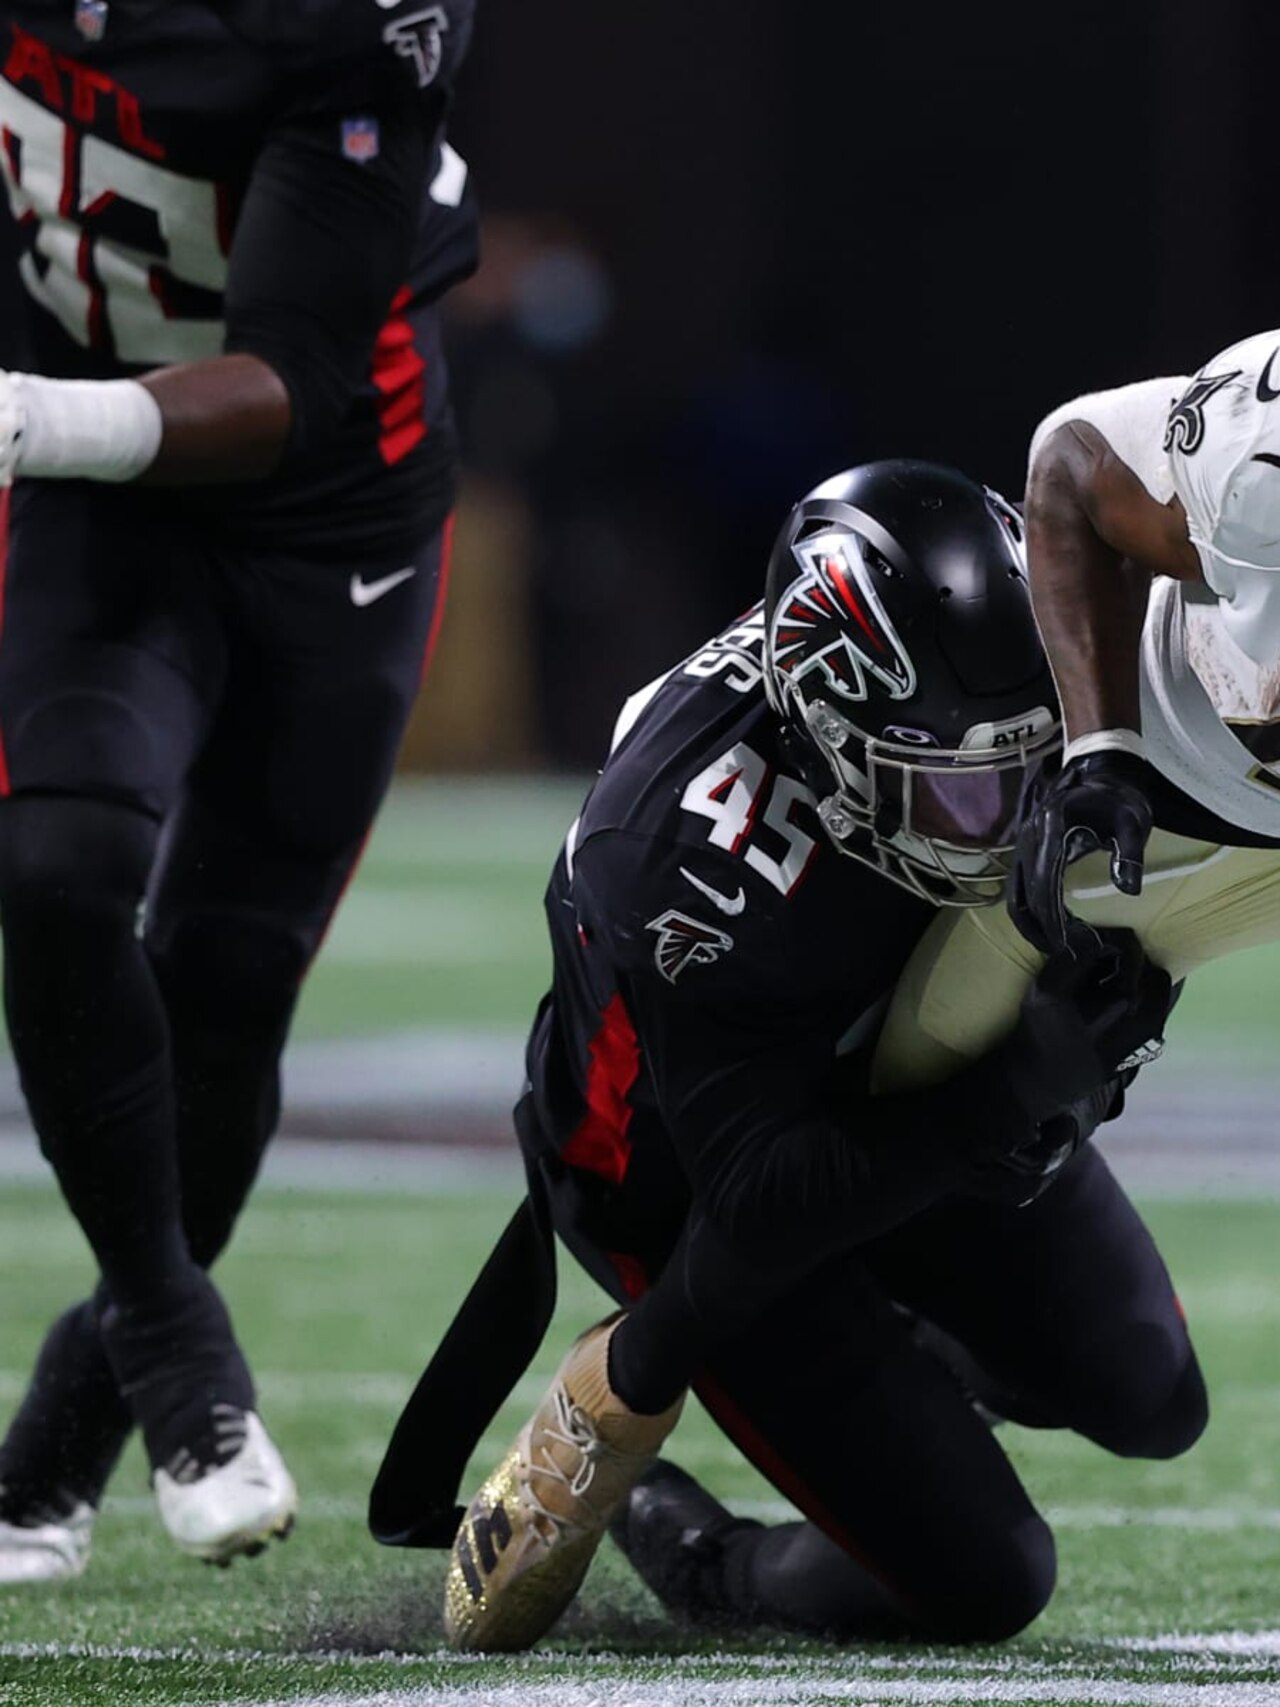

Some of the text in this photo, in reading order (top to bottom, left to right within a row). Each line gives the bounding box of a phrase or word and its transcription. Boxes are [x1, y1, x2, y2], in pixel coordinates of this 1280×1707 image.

[3, 22, 167, 158] ATL
[992, 724, 1038, 748] ATL
[679, 741, 821, 901] 45
